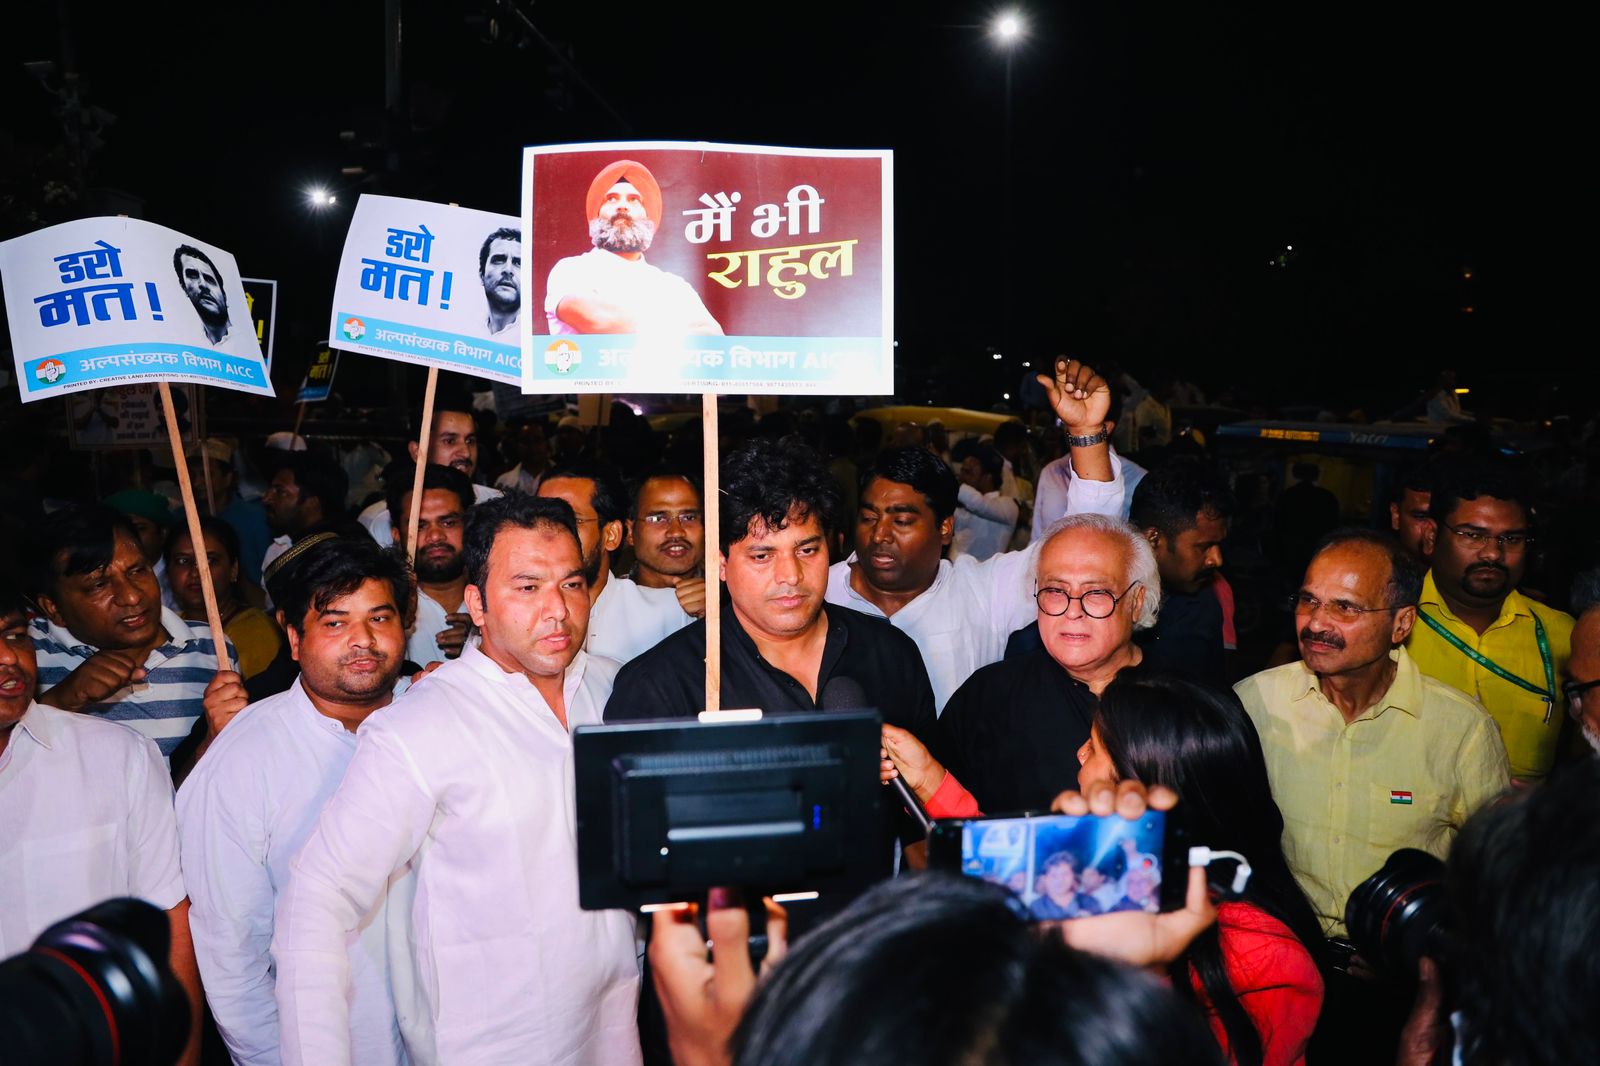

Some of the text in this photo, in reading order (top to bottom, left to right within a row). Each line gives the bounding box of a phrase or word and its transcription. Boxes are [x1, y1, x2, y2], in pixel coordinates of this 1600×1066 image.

[682, 184, 825, 243] मैं भी
[385, 224, 435, 263] डरो
[54, 240, 123, 284] डरो
[706, 239, 859, 299] राहुल
[374, 328, 449, 353] अल्पसंख्यक
[453, 340, 493, 361] विभाग
[730, 345, 796, 369] विभाग
[80, 351, 254, 379] अल्पसंख्यक विभाग AICC
[63, 381, 88, 389] PRINTED
[1348, 431, 1390, 445] Yatri
